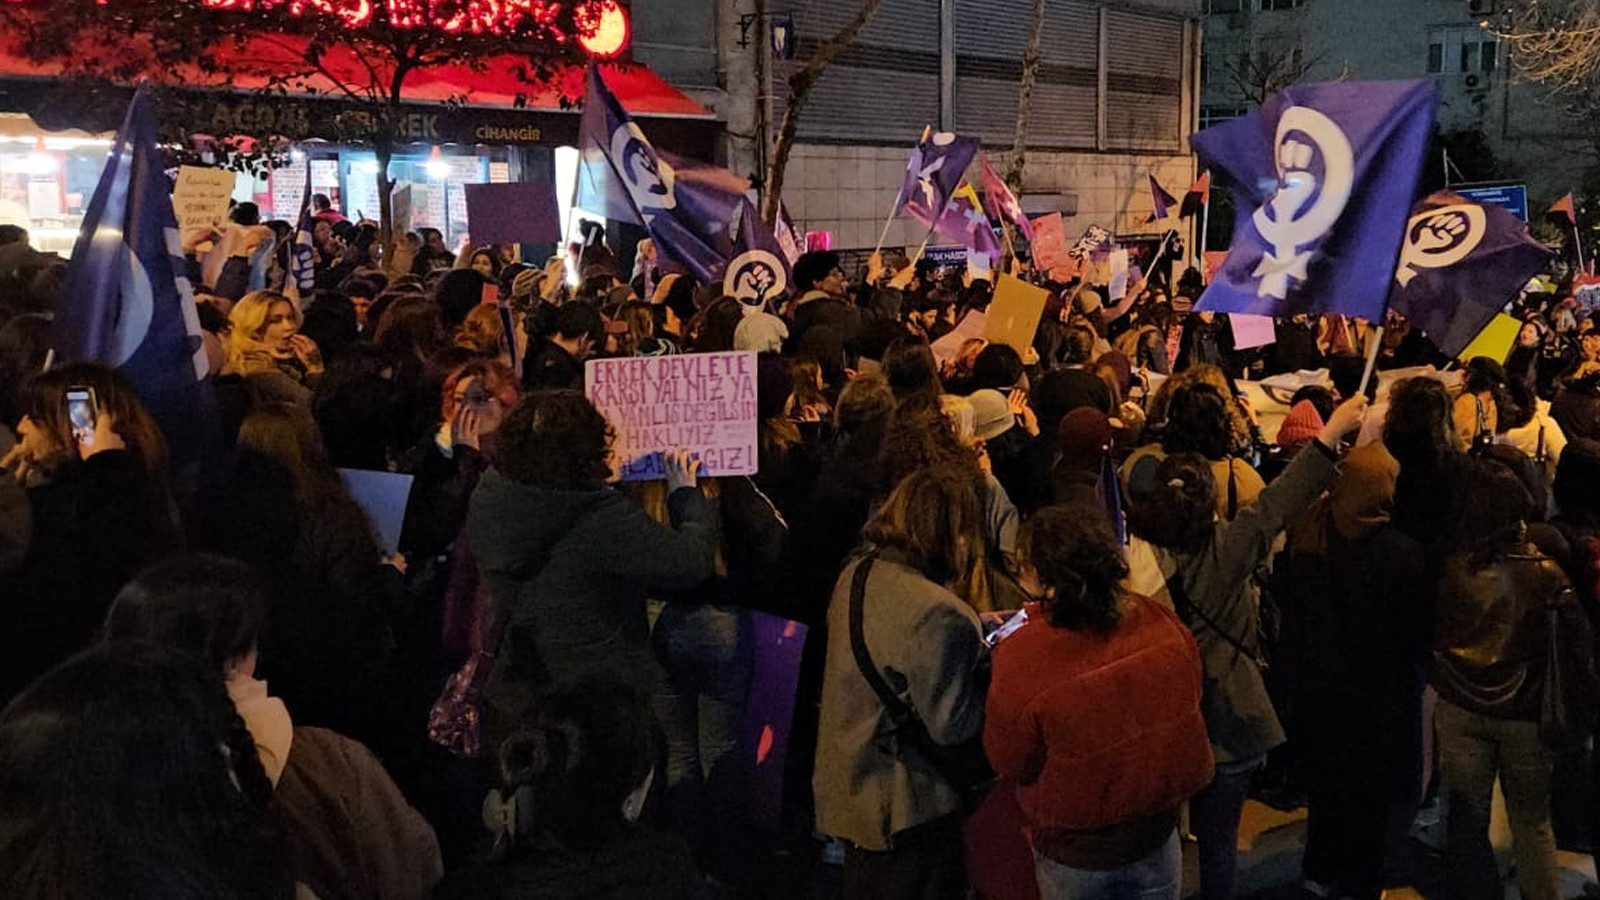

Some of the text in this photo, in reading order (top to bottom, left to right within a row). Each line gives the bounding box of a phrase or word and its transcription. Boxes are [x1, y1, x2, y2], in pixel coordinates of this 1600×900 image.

[475, 124, 541, 141] CİHANGİR
[594, 354, 750, 384] ERKEK DEVLETE
[653, 377, 725, 404] YALNIZ
[731, 375, 755, 401] YA
[626, 424, 717, 450] HAKLIYIZ
